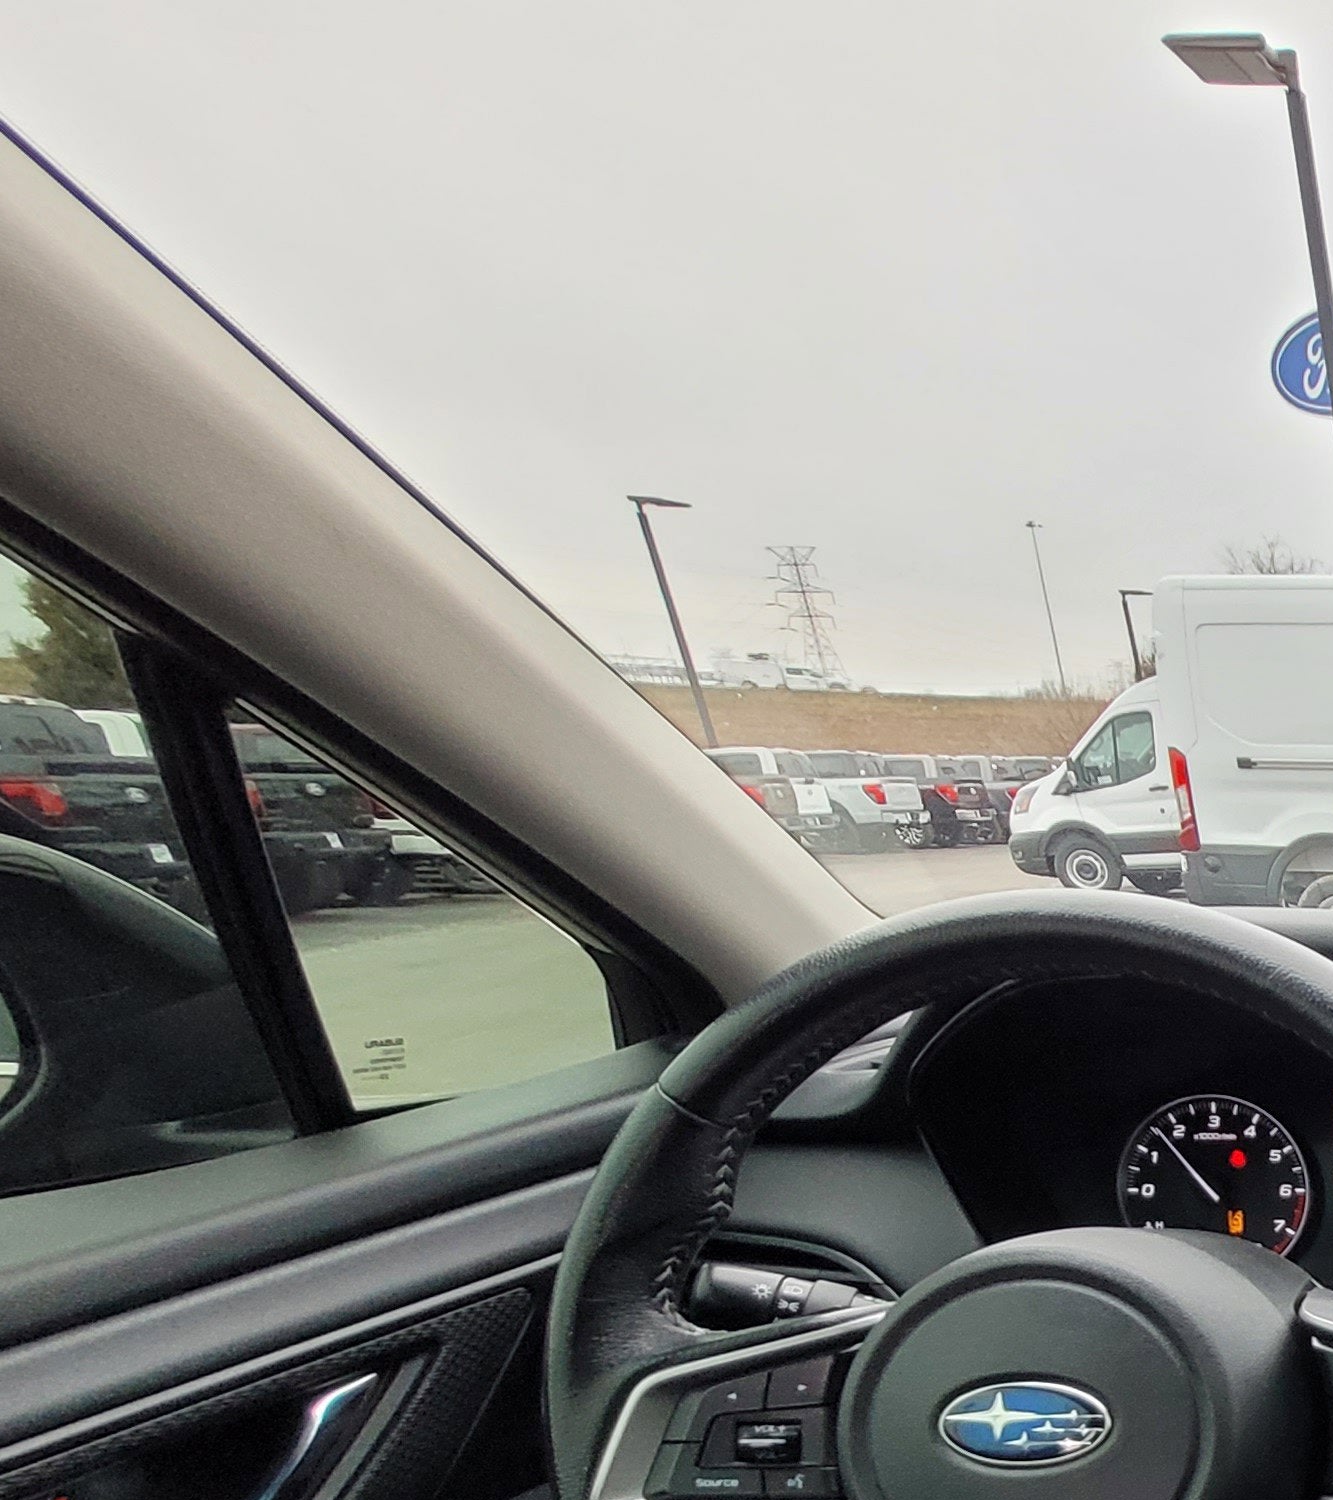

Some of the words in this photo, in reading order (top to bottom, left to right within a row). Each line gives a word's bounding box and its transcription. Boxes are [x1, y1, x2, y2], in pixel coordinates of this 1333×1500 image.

[1208, 1115, 1221, 1129] 3
[1172, 1125, 1186, 1139] 2
[1243, 1125, 1256, 1138] 4
[1151, 1151, 1159, 1164] 1
[1269, 1149, 1281, 1163] 5
[1141, 1183, 1155, 1198] 0
[1279, 1184, 1293, 1198] 6
[1272, 1219, 1286, 1233] 7
[695, 1477, 739, 1489] Source
